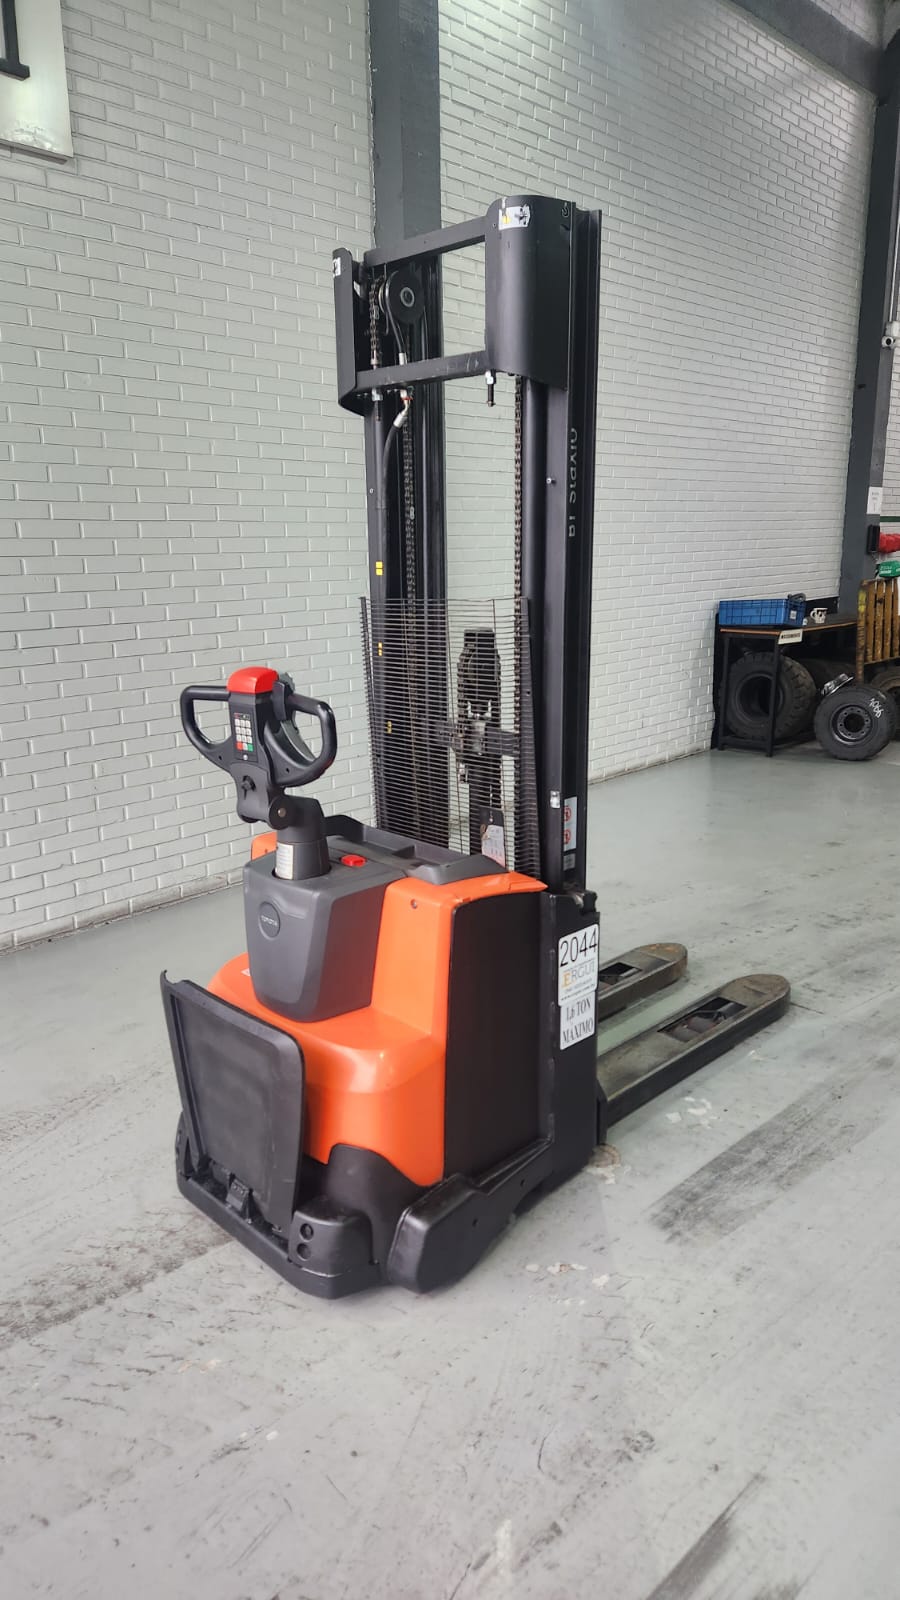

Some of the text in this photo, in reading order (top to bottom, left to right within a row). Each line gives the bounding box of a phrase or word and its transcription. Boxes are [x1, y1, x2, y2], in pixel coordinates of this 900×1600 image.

[560, 927, 598, 967] 2044
[576, 998, 591, 1016] TON
[562, 1017, 594, 1044] MAXIMO
